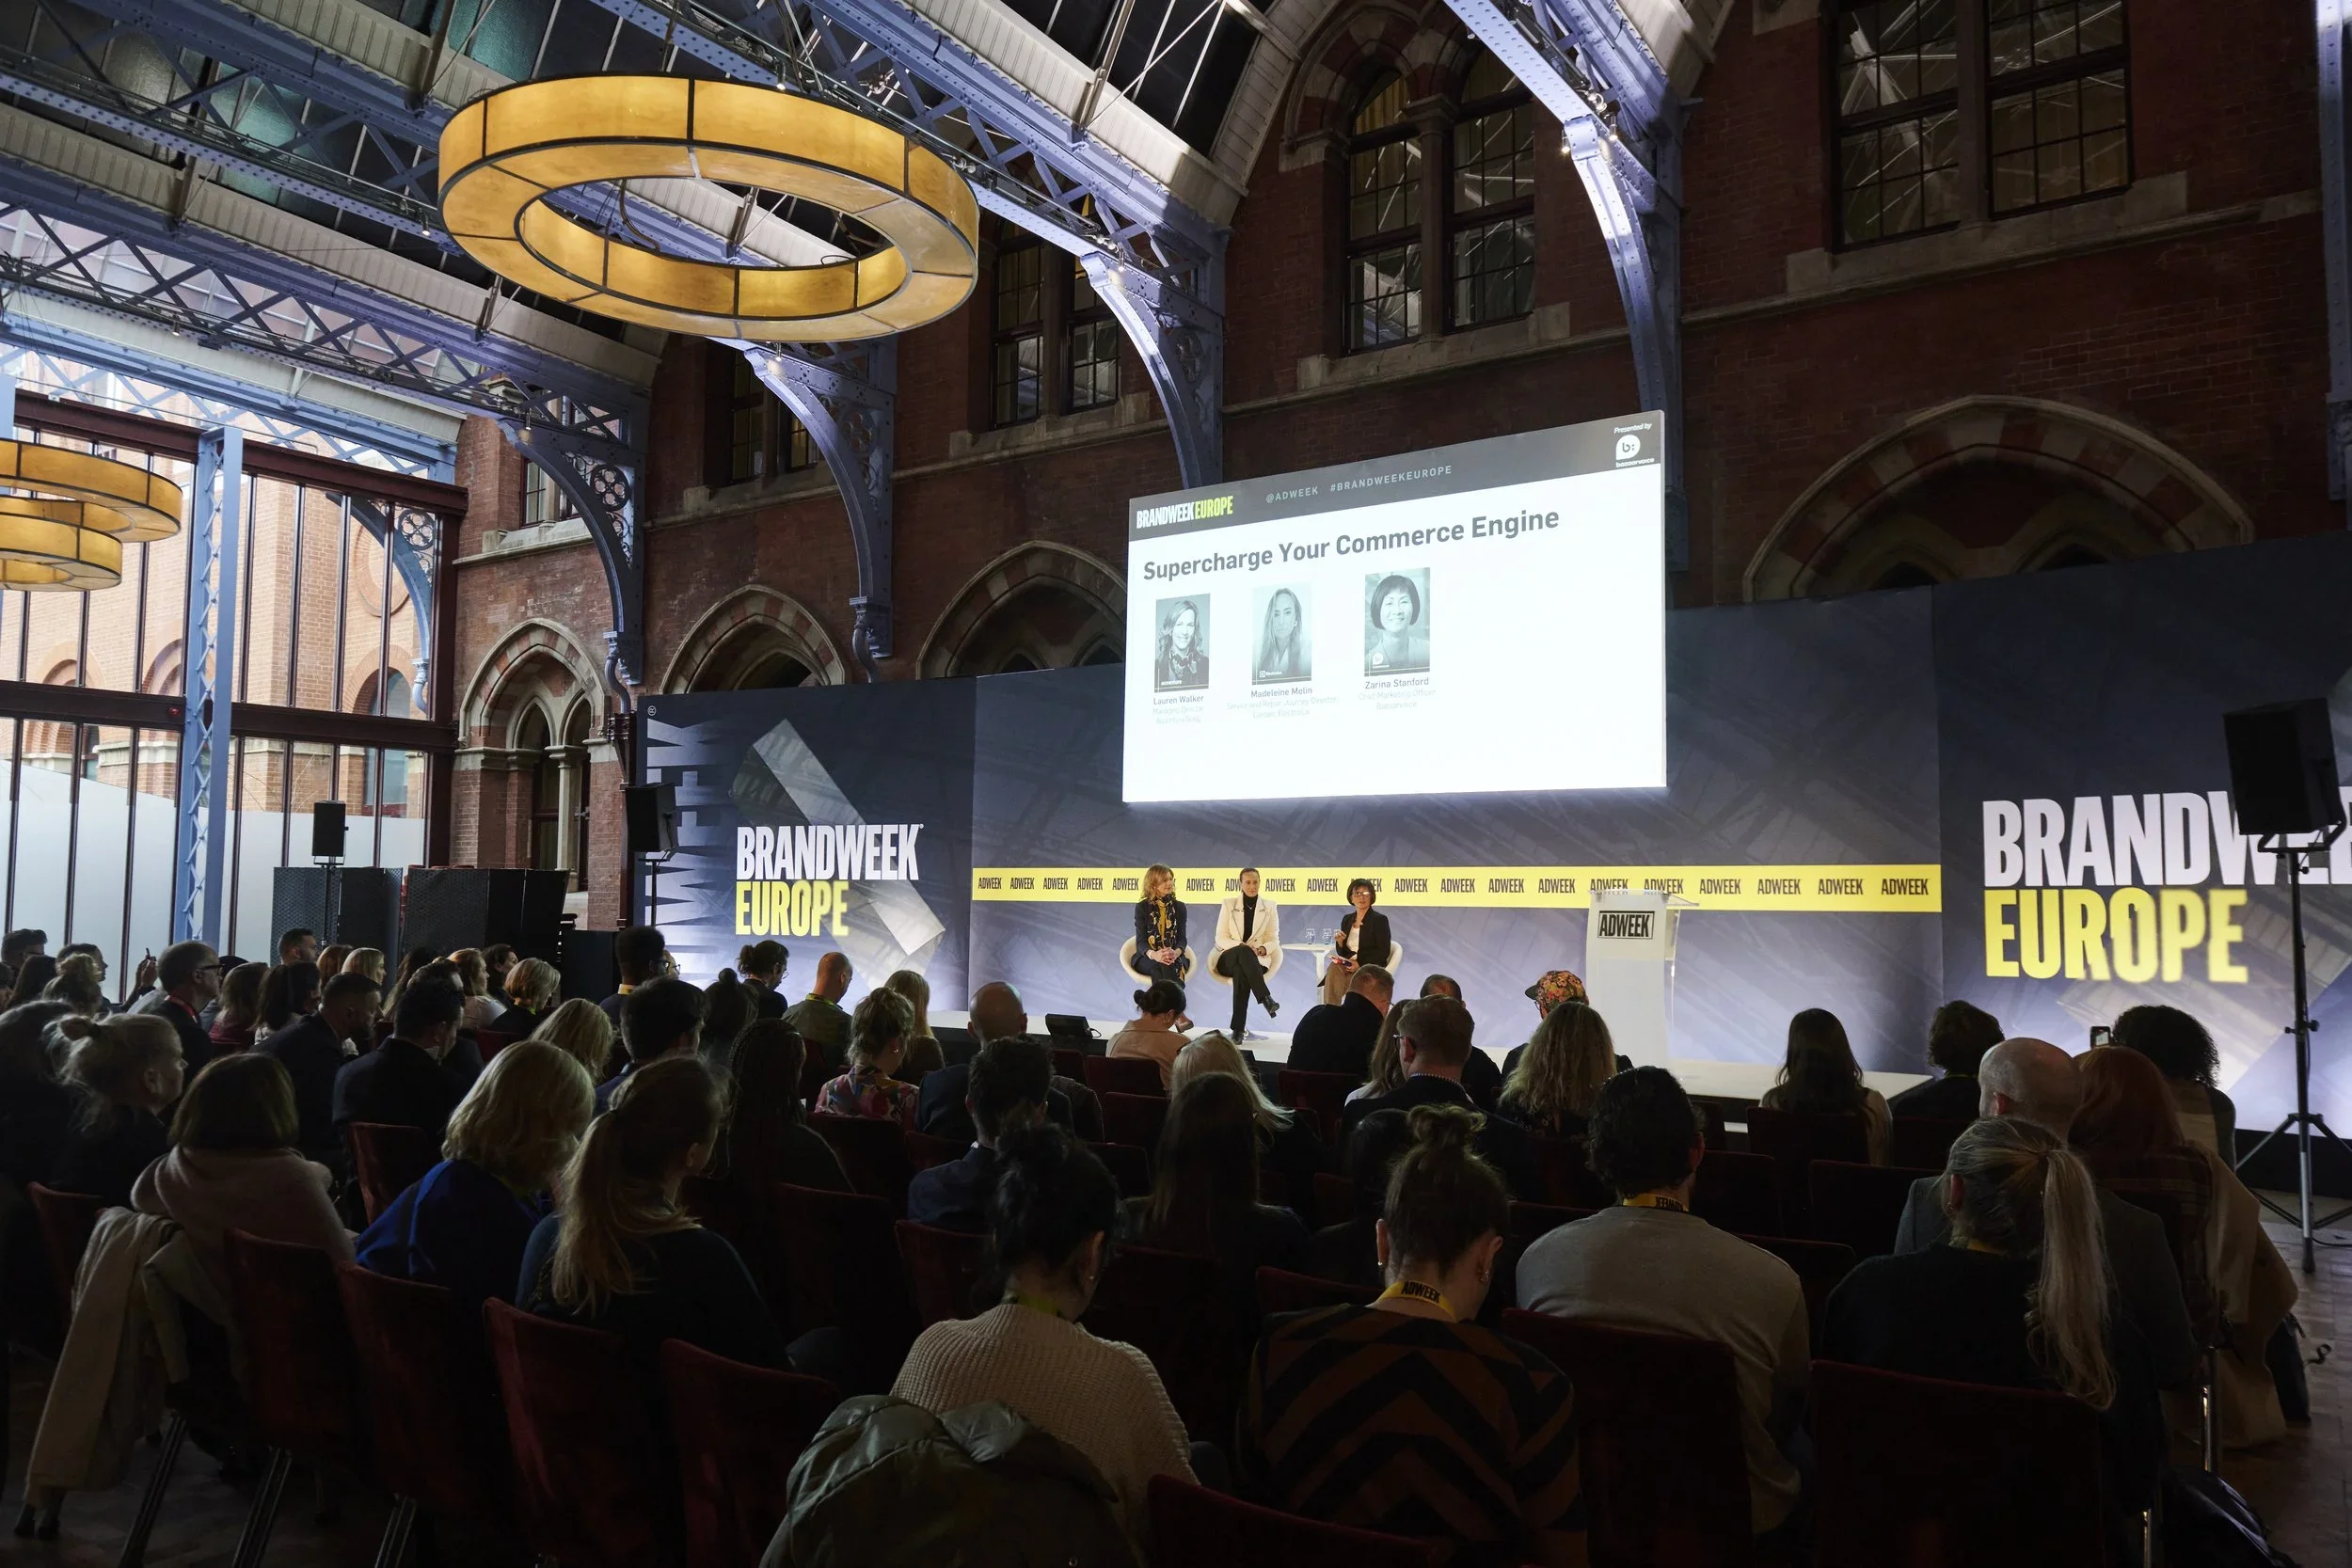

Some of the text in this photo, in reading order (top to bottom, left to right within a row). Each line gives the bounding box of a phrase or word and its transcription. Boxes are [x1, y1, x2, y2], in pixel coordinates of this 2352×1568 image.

[1613, 423, 1644, 434] Presented
[1615, 458, 1655, 467] bazaarvoice
[1265, 465, 1453, 503] @ADWEEK #BRANDWEEKEUROPE
[1143, 510, 1560, 581] Supercharge Your Commerce Engine
[1250, 686, 1313, 698] Madeleine Melin
[1364, 676, 1430, 689] Zarina Stanford
[736, 823, 920, 880] BRANDWEEK
[977, 877, 1002, 889] ADWEEK
[1009, 877, 1035, 889] ADWEEK
[1042, 877, 1069, 890] ADWEEK
[1076, 878, 1104, 891] ADWEEK
[1112, 878, 1139, 891] ADWEEK
[1185, 878, 1215, 892] ADWEEK
[1264, 878, 1295, 892] ADWEEK
[1306, 878, 1338, 892] ADWEEK
[1393, 878, 1428, 893] ADWEEK
[1440, 878, 1475, 893] ADWEEK
[1487, 878, 1525, 894] ADWEEK
[1537, 879, 1576, 894] ADWEEK
[1644, 879, 1684, 894] ADWEEK
[1699, 879, 1741, 895] ADWEEK
[1756, 879, 1802, 895] ADWEEK
[1818, 878, 1864, 895] ADWEEK
[1881, 878, 1930, 895] ADWEEK
[735, 879, 850, 937] EUROPE
[1599, 913, 1650, 938] ADWEEK
[1984, 887, 2249, 984] EUROPE
[1400, 1281, 1440, 1305] ADWEEK
